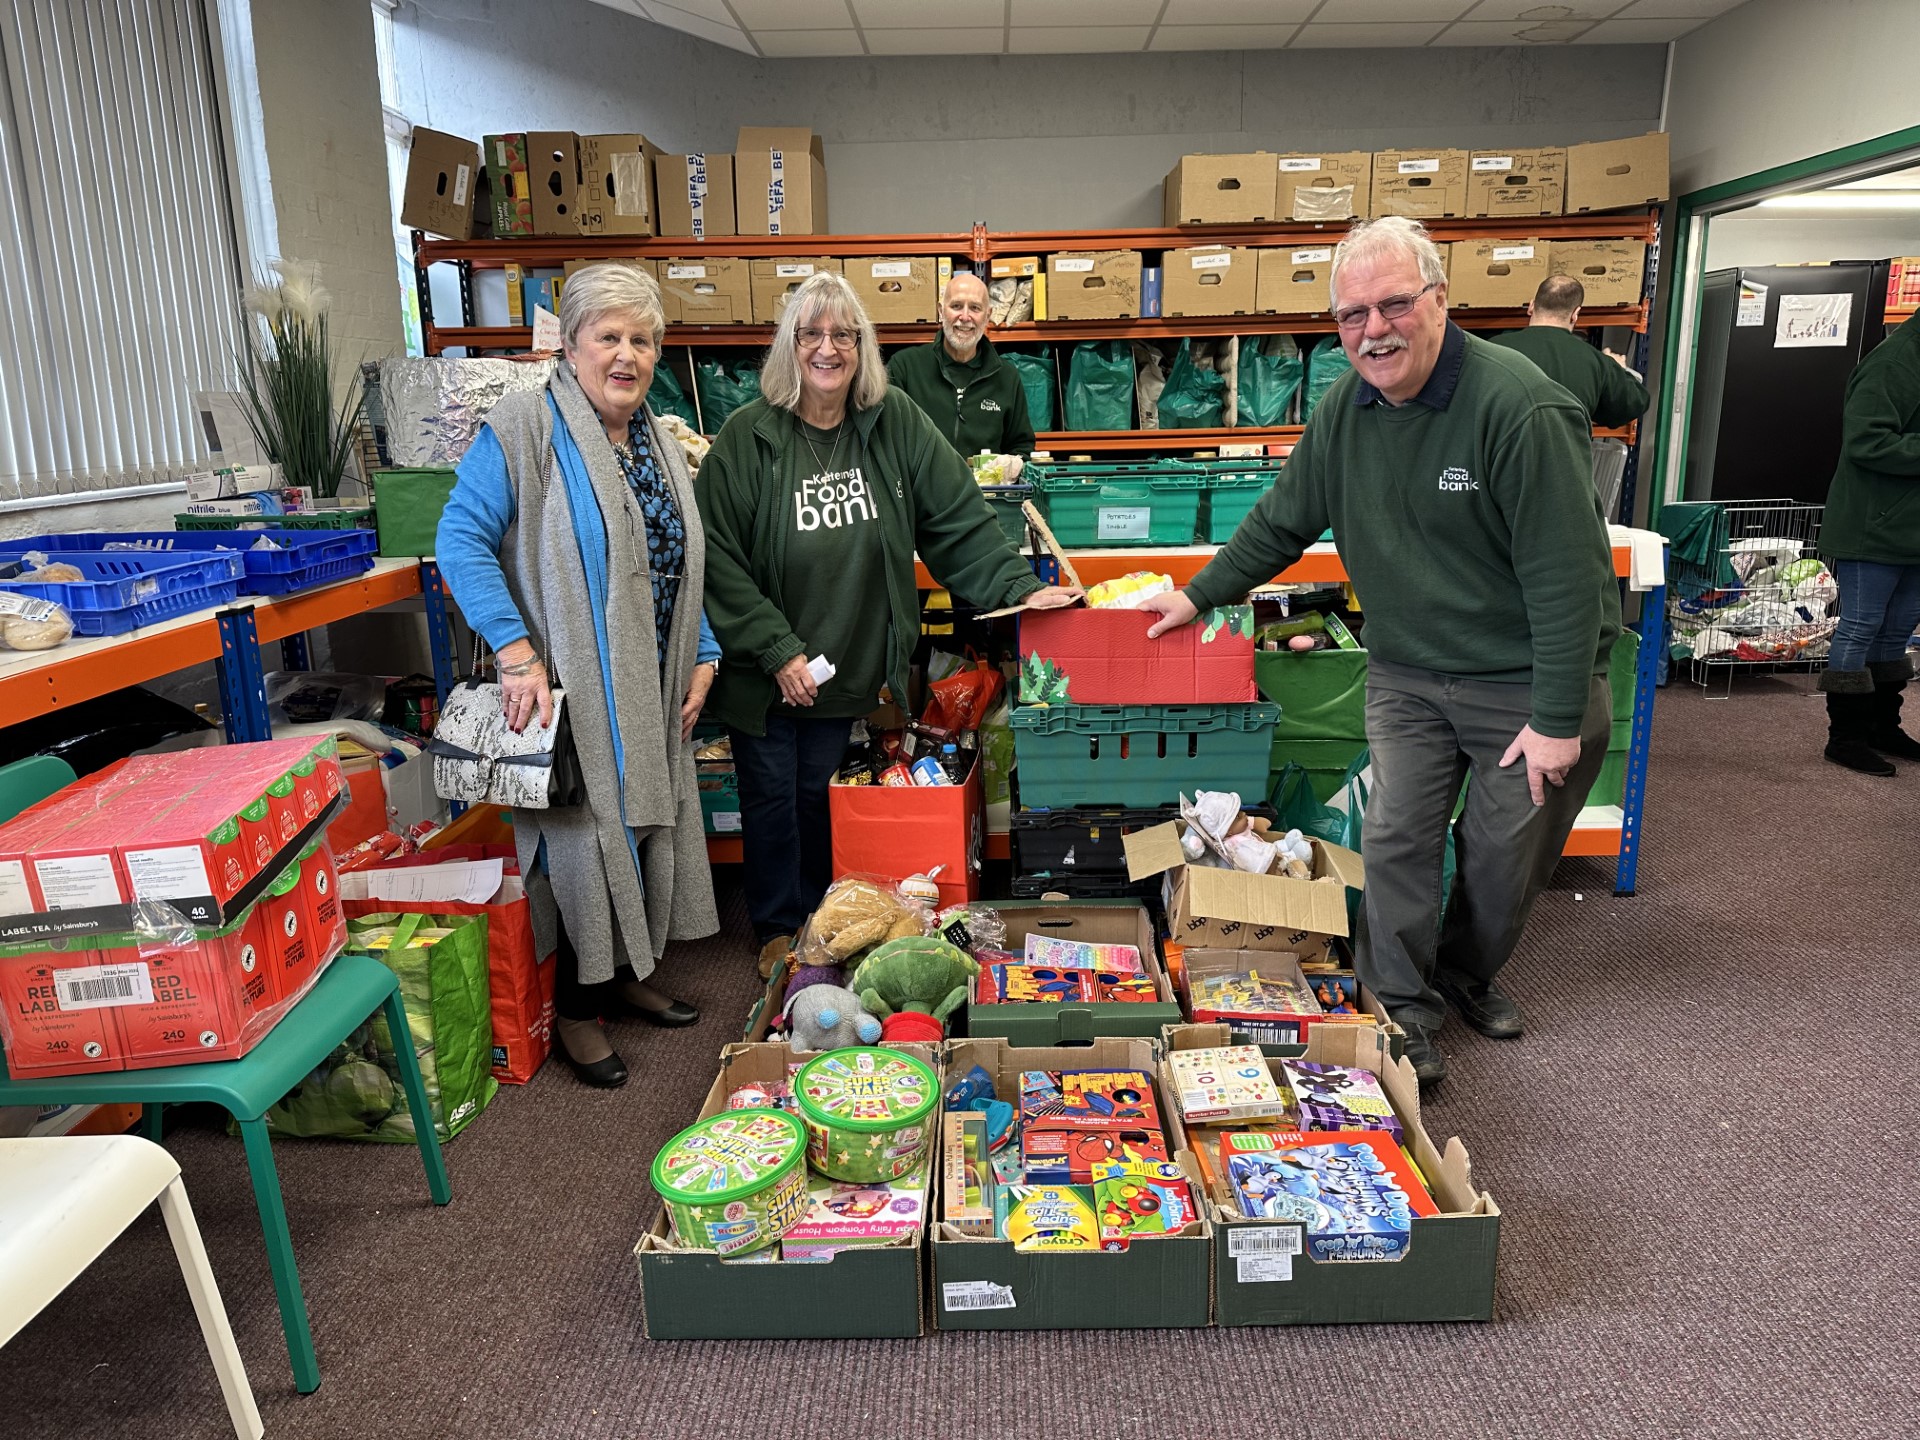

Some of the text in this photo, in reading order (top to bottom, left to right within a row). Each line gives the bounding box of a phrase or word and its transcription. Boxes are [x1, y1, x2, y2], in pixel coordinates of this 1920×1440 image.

[1443, 469, 1469, 481] Food
[802, 467, 866, 505] Food
[1438, 475, 1480, 491] bank
[187, 504, 216, 514] nitrile
[191, 906, 206, 915] 40
[318, 907, 337, 925] FUTURE
[1, 920, 99, 937] LABEL TEA by Sainsbury's
[1186, 916, 1207, 931] bbp
[1220, 921, 1241, 936] bbp
[1254, 925, 1275, 941] bbp
[1288, 930, 1309, 945] bbp
[285, 949, 306, 970] FUTURE
[243, 984, 266, 1008] FUTURE
[19, 1000, 61, 1015] LAB
[162, 1029, 186, 1040] 240
[46, 1040, 69, 1051] 240
[844, 1076, 891, 1086] SUPER
[1196, 1071, 1216, 1084] 10
[844, 1085, 894, 1096] STARS
[1188, 1109, 1227, 1119] Number Puzzle
[712, 1137, 756, 1157] STARS
[703, 1147, 741, 1165] SUPER
[767, 1174, 805, 1217] SUPER
[1025, 1207, 1057, 1217] Tips
[1163, 1186, 1187, 1228] ladybirds
[1182, 1201, 1191, 1212] game
[1031, 1215, 1080, 1225] Super
[794, 1226, 821, 1236] House
[825, 1225, 866, 1236] Pompom
[870, 1224, 892, 1235] Fairy
[1363, 1233, 1399, 1251] Drop
[1328, 1249, 1385, 1260] PENGUINS
